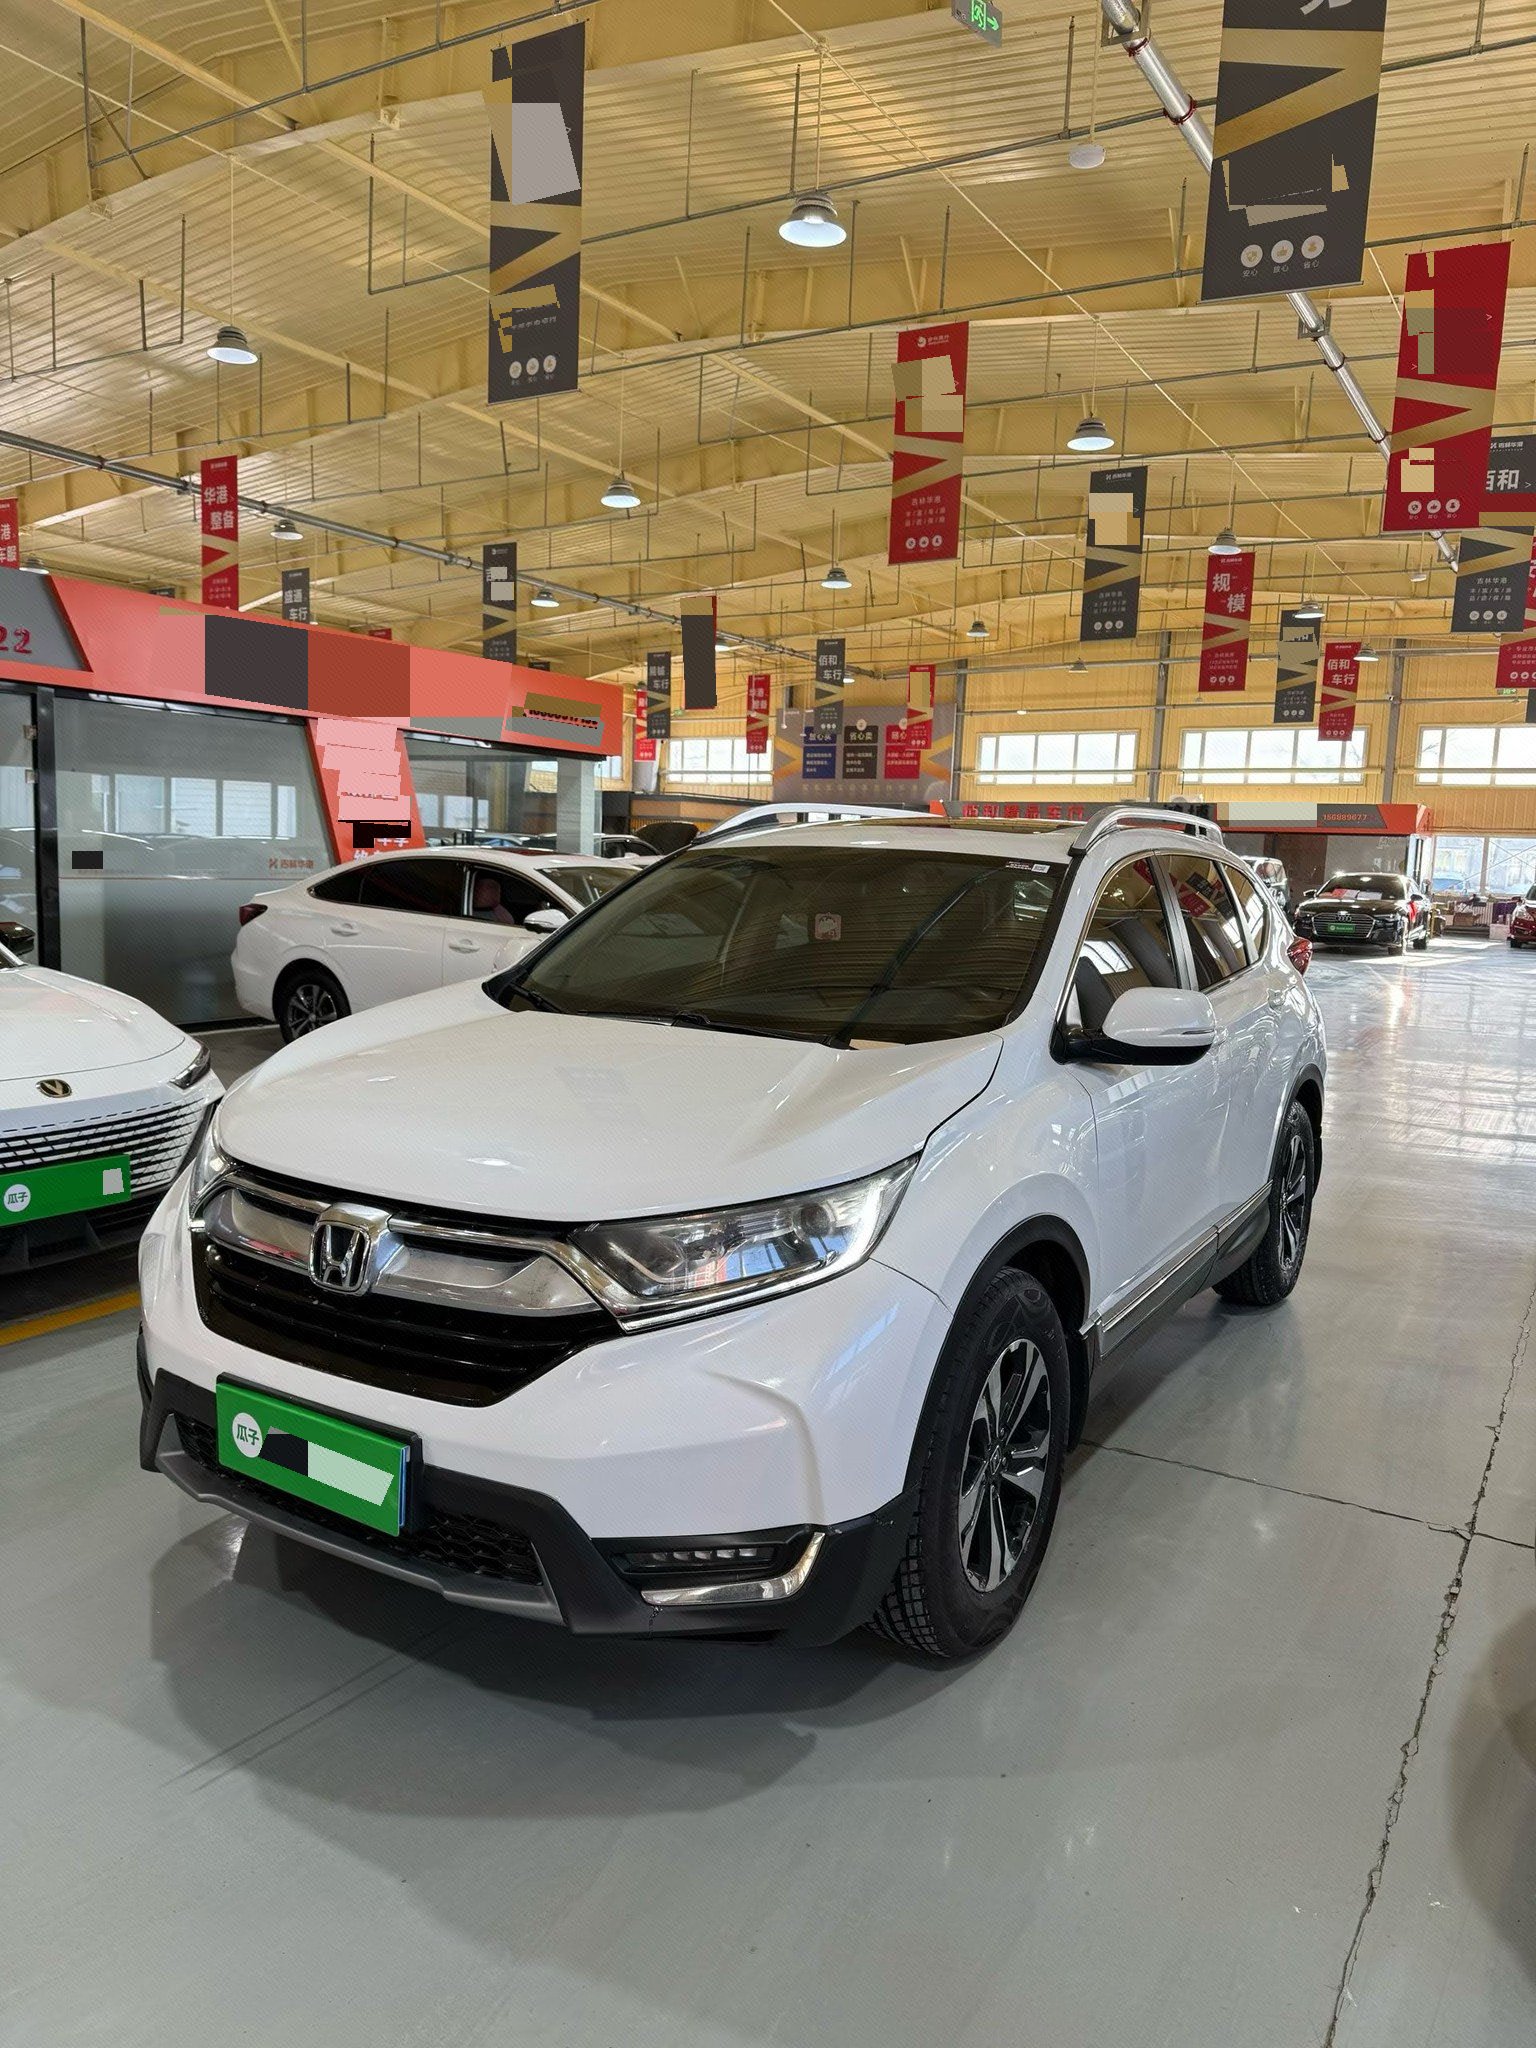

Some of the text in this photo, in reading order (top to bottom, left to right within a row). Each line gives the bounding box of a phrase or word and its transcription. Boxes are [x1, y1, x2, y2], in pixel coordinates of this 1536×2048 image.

[204, 485, 228, 505] 华港
[210, 510, 234, 530] 整备
[1212, 573, 1231, 593] 规
[1227, 593, 1246, 613] 模
[289, 607, 308, 621] 车行
[819, 655, 837, 666] 佰和
[1328, 659, 1350, 671] 佰和
[823, 669, 842, 680] 车行
[1331, 674, 1355, 686] 车行
[7, 1191, 28, 1205] 瓜子
[236, 1424, 260, 1446] 瓜子
